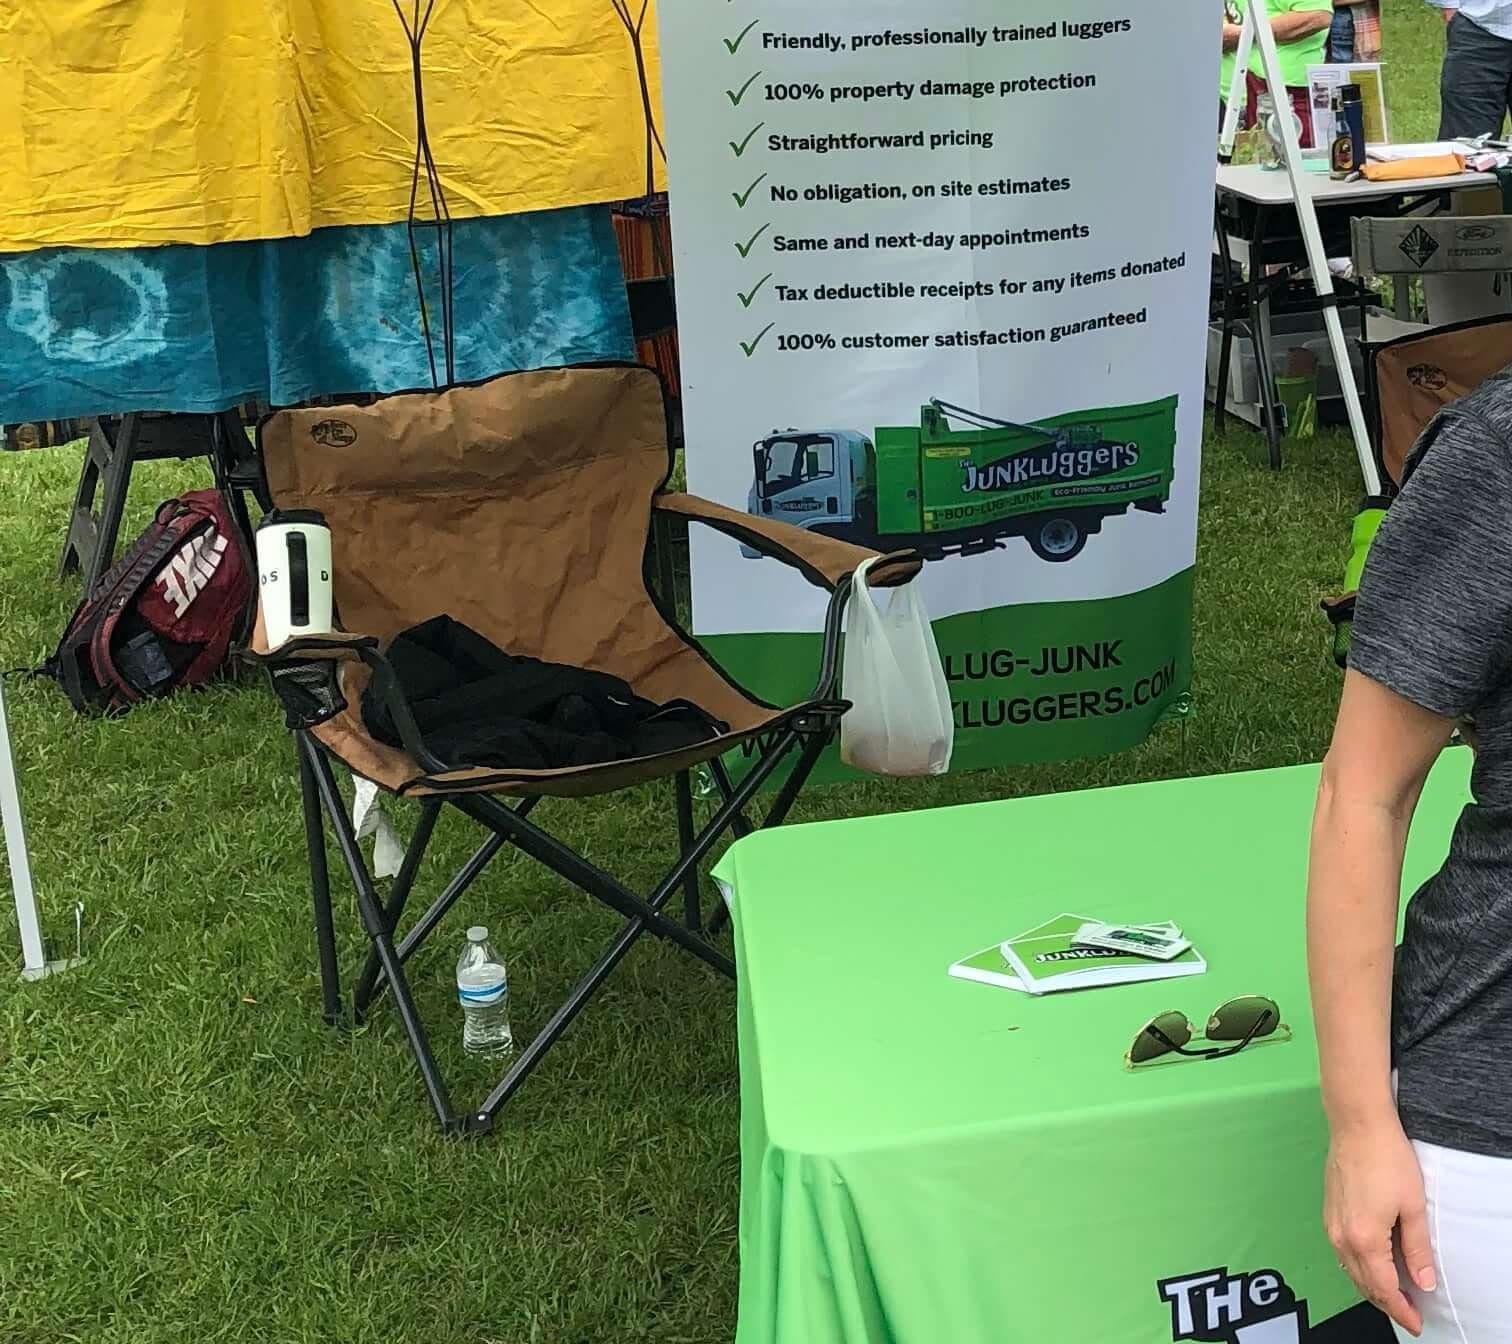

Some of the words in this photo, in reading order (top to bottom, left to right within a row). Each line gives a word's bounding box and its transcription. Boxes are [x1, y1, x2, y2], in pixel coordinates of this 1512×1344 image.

[762, 31, 847, 53] Friendly,
[851, 26, 987, 50] professionally
[991, 21, 1057, 43] trained
[1061, 16, 1132, 39] luggers
[764, 83, 825, 102] 100%
[830, 82, 914, 103] property
[919, 77, 996, 100] damage
[1000, 70, 1097, 94] protection
[767, 130, 925, 156] Straightforward
[930, 128, 994, 154] pricing
[770, 185, 798, 203] No
[803, 181, 907, 205] obligation,
[911, 184, 936, 198] on
[940, 179, 973, 198] site
[977, 174, 1072, 195] estimates
[773, 233, 829, 253] Same
[833, 231, 870, 251] and
[875, 230, 955, 252] next-day
[960, 222, 1091, 251] appointments
[775, 285, 808, 302] Tax
[813, 280, 916, 302] deductible
[920, 278, 994, 301] receipts
[999, 277, 1027, 295] for
[1031, 277, 1066, 298] any
[1070, 267, 1117, 289] items
[1121, 253, 1187, 278] donated
[777, 332, 836, 352] 100%
[841, 331, 930, 351] customer
[934, 325, 1046, 349] satisfaction
[1050, 309, 1148, 343] guaranteed
[1164, 1273, 1280, 1336] THe
